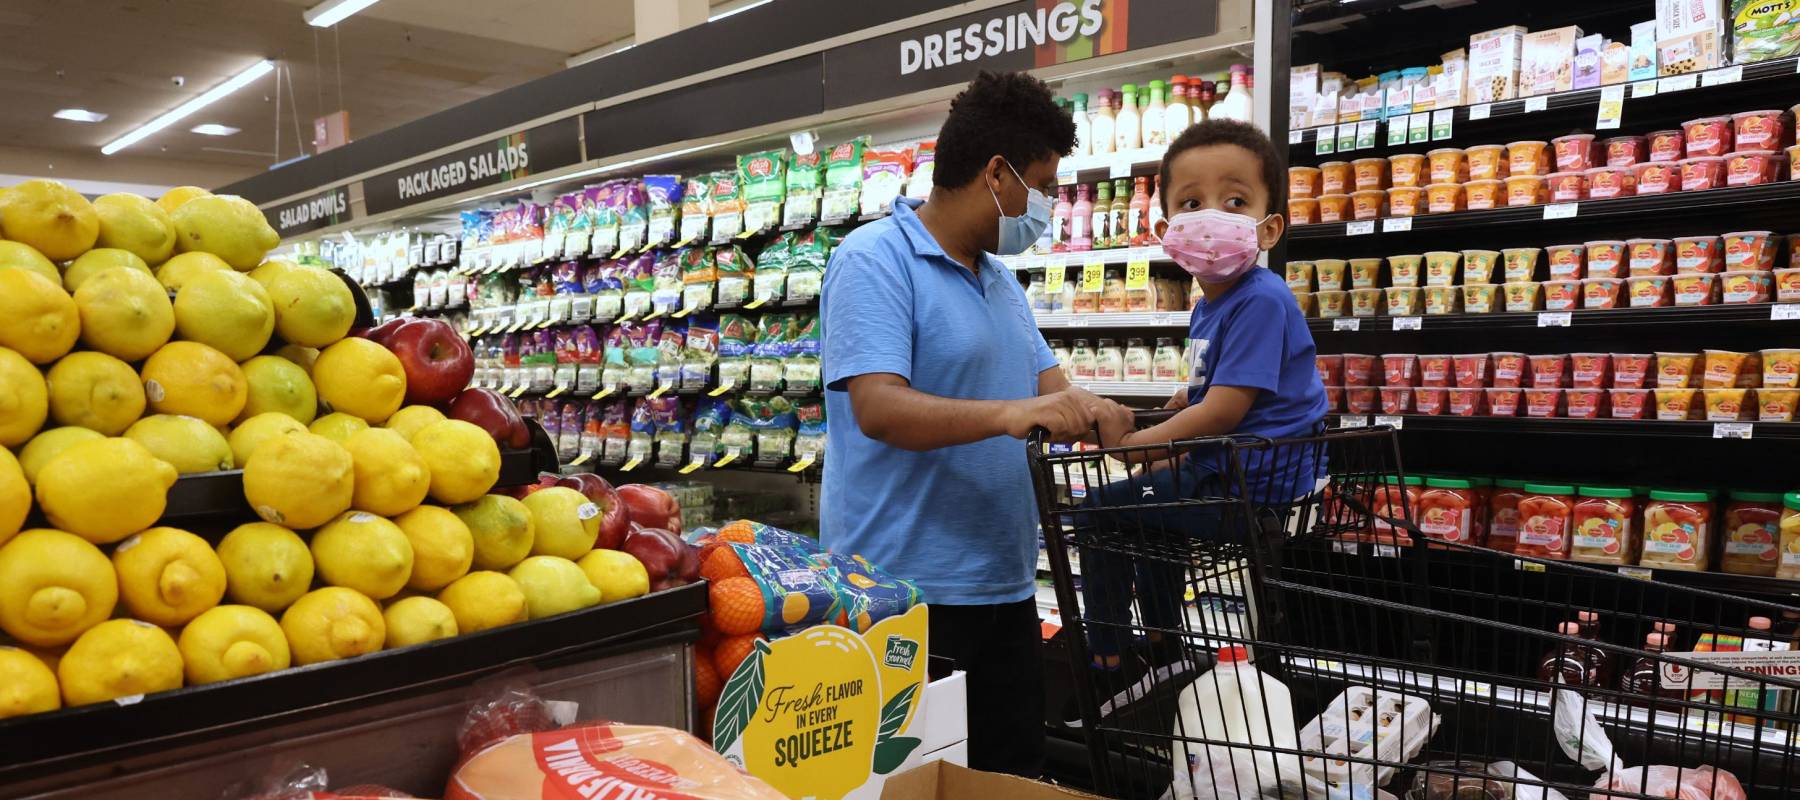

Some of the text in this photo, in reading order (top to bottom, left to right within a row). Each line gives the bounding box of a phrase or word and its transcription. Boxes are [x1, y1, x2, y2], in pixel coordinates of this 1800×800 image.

[900, 0, 1103, 75] DRESSINGS
[398, 142, 528, 200] PACKAGED SALADS
[280, 192, 346, 230] SALAD BOWLS
[886, 650, 914, 666] Gourmet
[893, 641, 912, 656] Fresh
[764, 680, 863, 723] Fresh FLAVOR
[796, 705, 838, 729] IN EVERY
[775, 720, 854, 768] SQUEEZE
